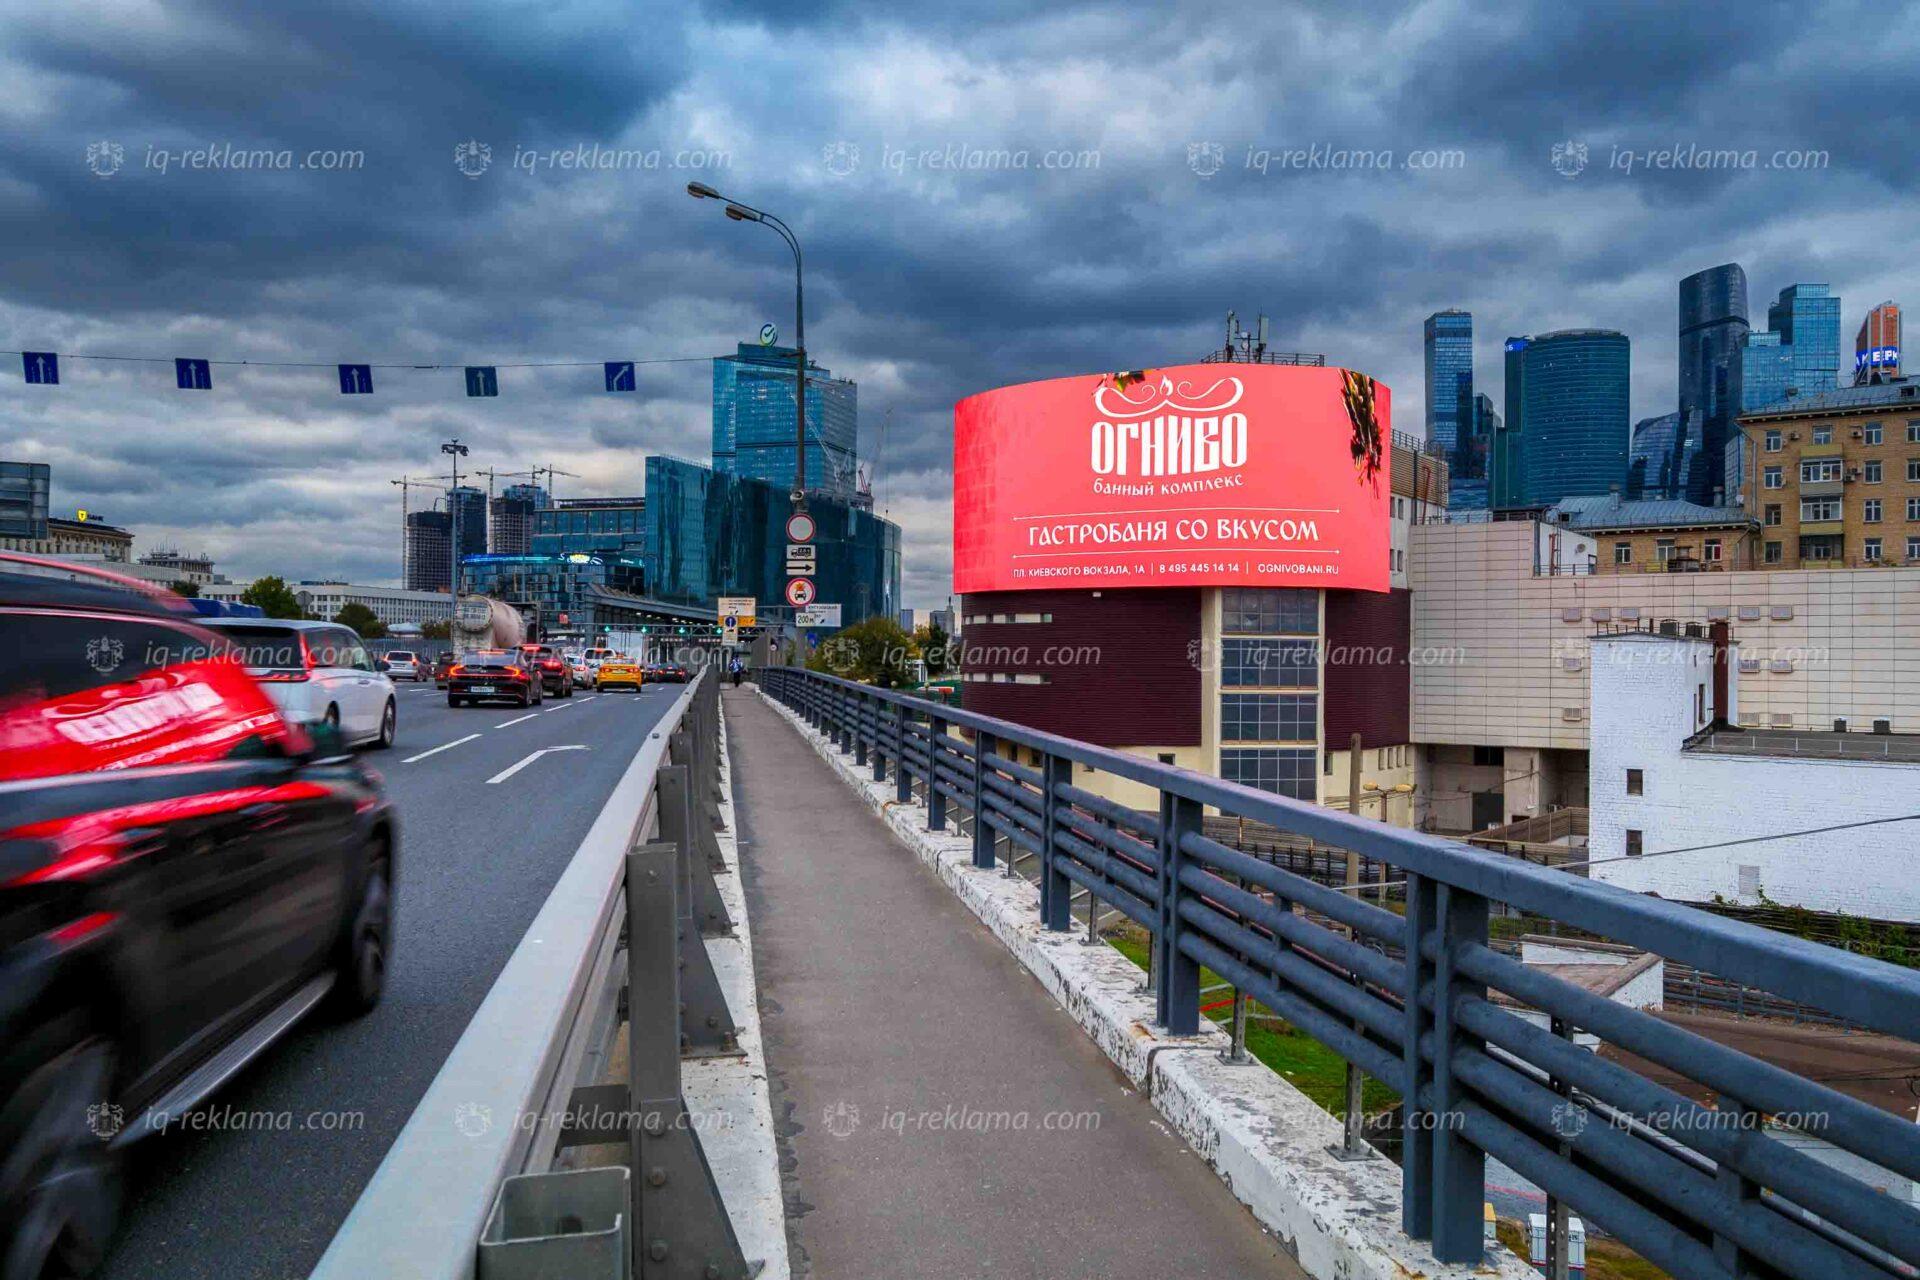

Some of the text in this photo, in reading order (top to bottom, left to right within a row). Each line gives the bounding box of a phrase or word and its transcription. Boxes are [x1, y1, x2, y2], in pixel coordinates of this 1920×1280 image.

[1091, 413, 1247, 476] ОГНИВО
[1093, 474, 1244, 496] банный комплекс
[1029, 519, 1319, 546] ГАСТРОБАНЯ СО ВКУСОМ
[1028, 566, 1081, 577] КИЕВСКОГО
[1083, 564, 1131, 576] ВОКЗАЛА,
[1159, 564, 1166, 573] 8
[1168, 563, 1187, 572] 495
[1190, 563, 1210, 572] 445
[1212, 563, 1225, 572] 14
[1227, 563, 1240, 572] 14
[1257, 563, 1339, 575] OGNIVOBANI.RU
